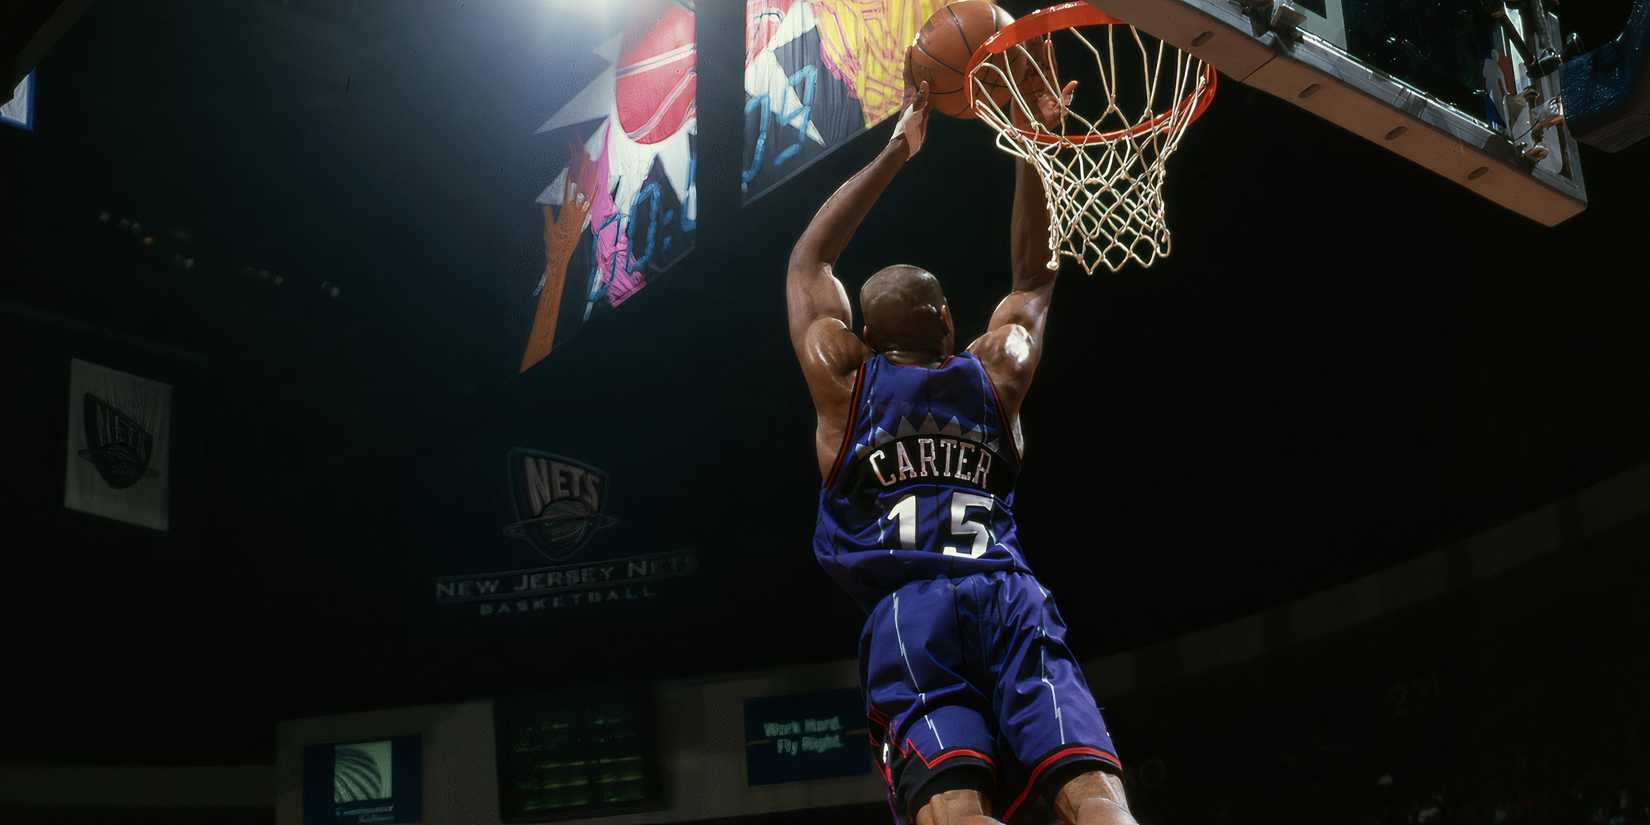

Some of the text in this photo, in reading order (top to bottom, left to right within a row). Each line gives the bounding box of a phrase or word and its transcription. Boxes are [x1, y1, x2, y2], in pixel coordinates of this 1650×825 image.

[523, 456, 603, 518] NETS
[869, 438, 992, 490] CARTER
[886, 491, 995, 560] 15
[435, 578, 501, 599] NEW
[512, 565, 615, 592] JERSEY
[479, 585, 657, 617] BASKETBALL
